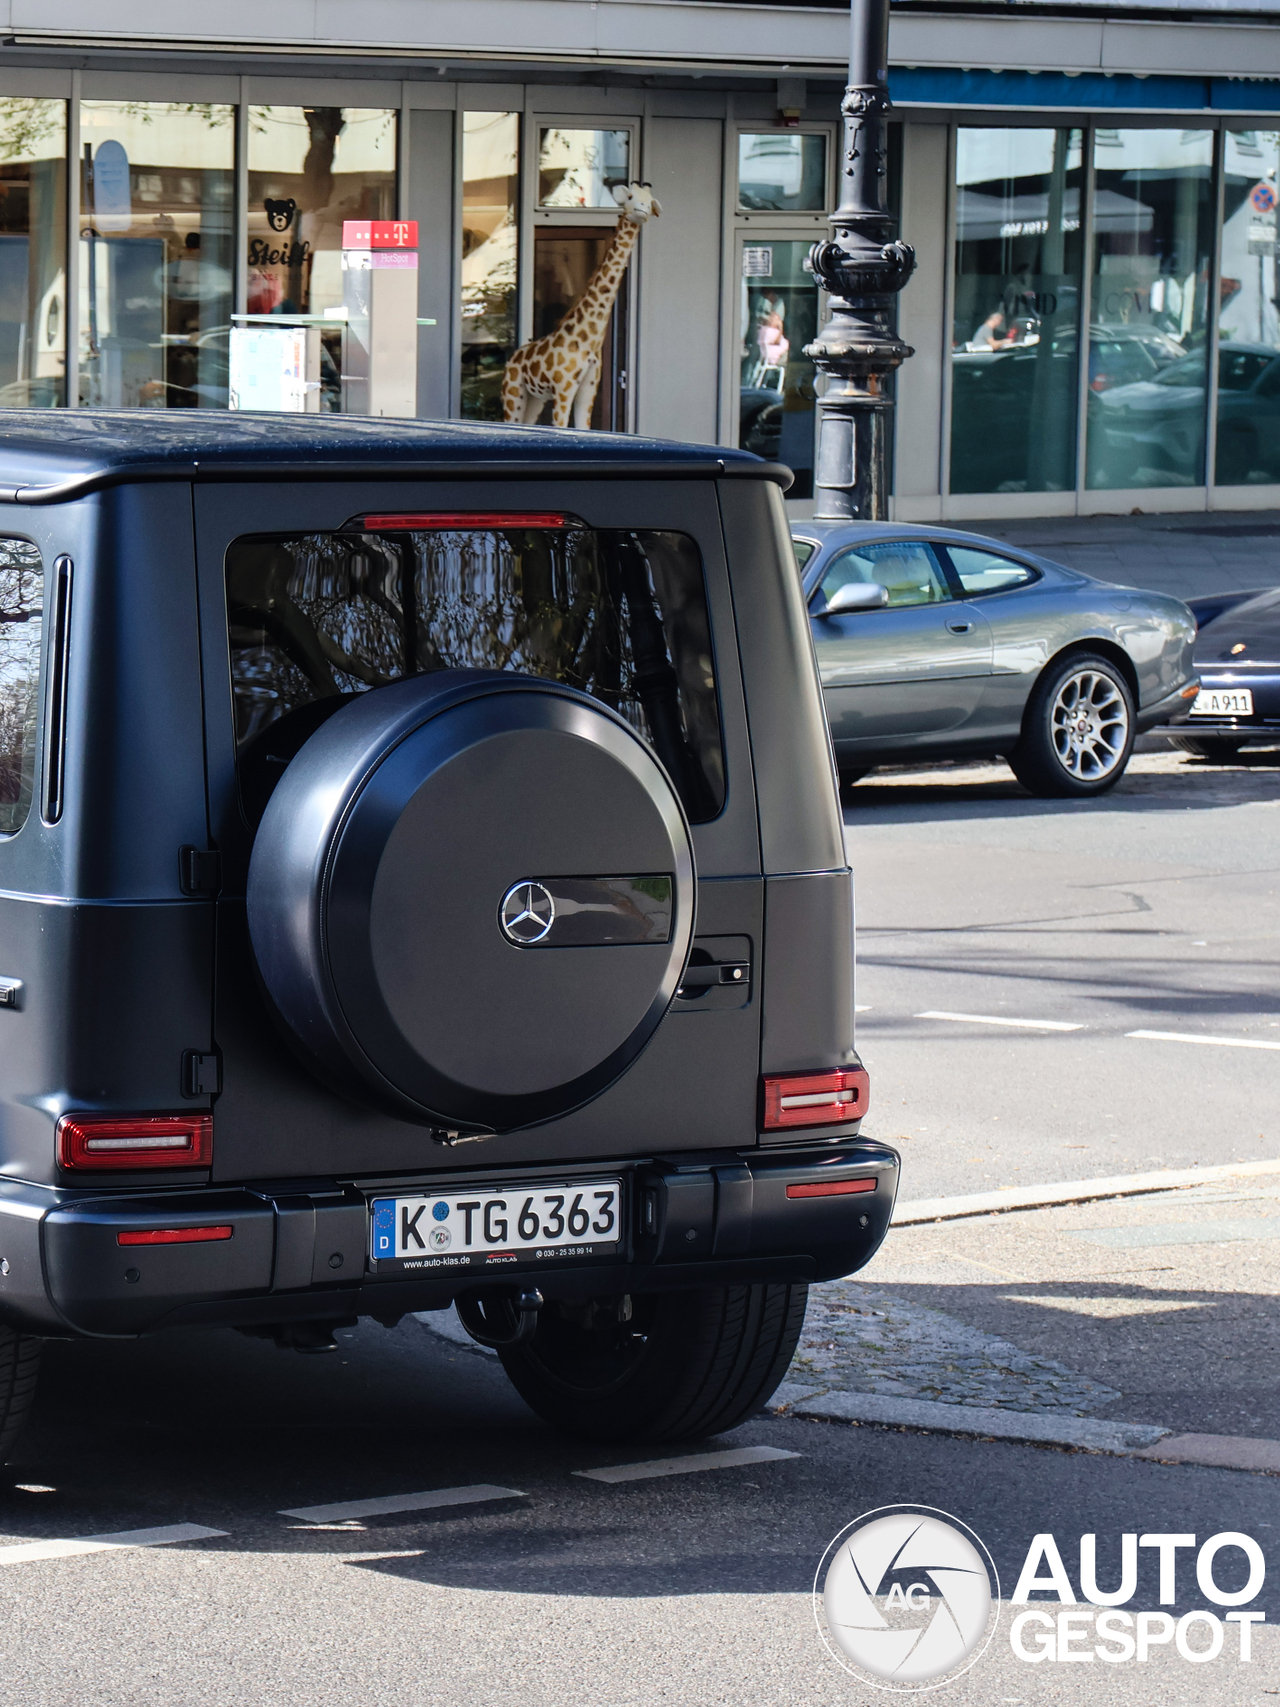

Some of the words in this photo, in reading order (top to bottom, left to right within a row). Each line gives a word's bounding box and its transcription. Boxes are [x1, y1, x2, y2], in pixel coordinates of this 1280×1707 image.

[394, 224, 408, 246] T
[248, 239, 310, 267] Steiff
[381, 253, 408, 264] HotSpot
[380, 1236, 389, 1249] D
[402, 1204, 427, 1250] K
[543, 1250, 555, 1258] 030
[568, 1248, 575, 1256] 35
[576, 1247, 585, 1255] 99
[403, 1256, 470, 1269] www.auto-klas.de
